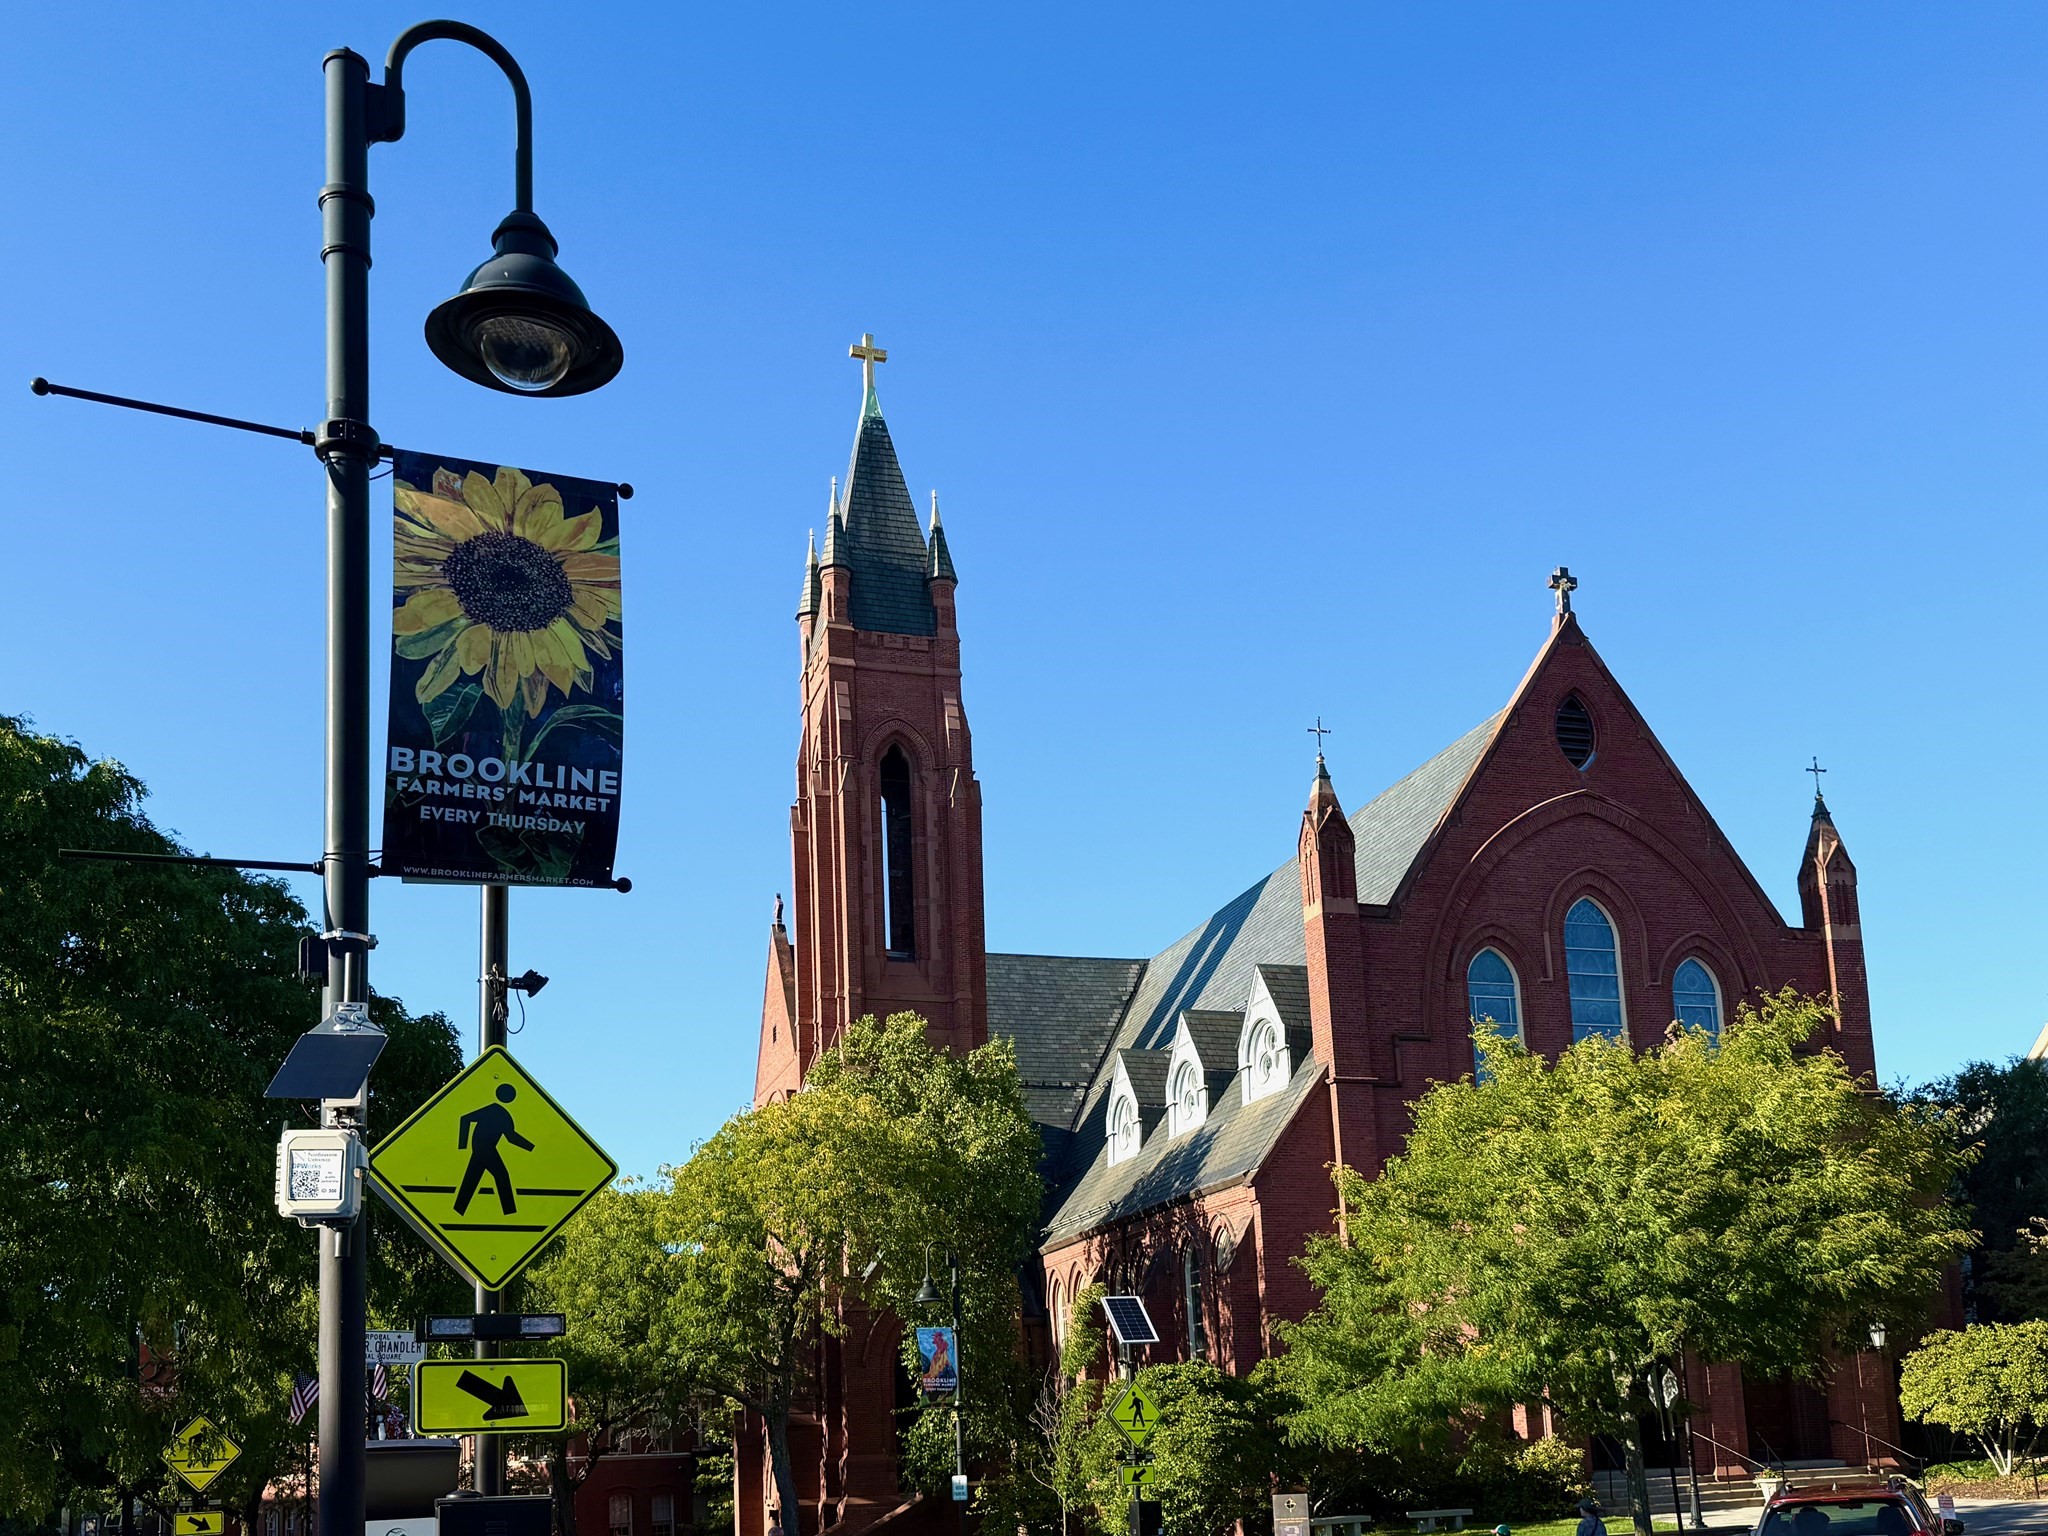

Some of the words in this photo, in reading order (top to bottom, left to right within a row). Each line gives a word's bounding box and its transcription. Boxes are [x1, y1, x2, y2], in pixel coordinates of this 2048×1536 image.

[390, 746, 618, 795] BROOKLINE
[396, 776, 513, 802] FARMERS'
[518, 789, 611, 812] MARKET
[420, 805, 481, 824] EVERY
[486, 812, 586, 834] THURSDAY
[403, 865, 594, 886] WWW.BROOKLINEFARMERSMARKET.COM
[375, 1341, 421, 1353] CHANDLER
